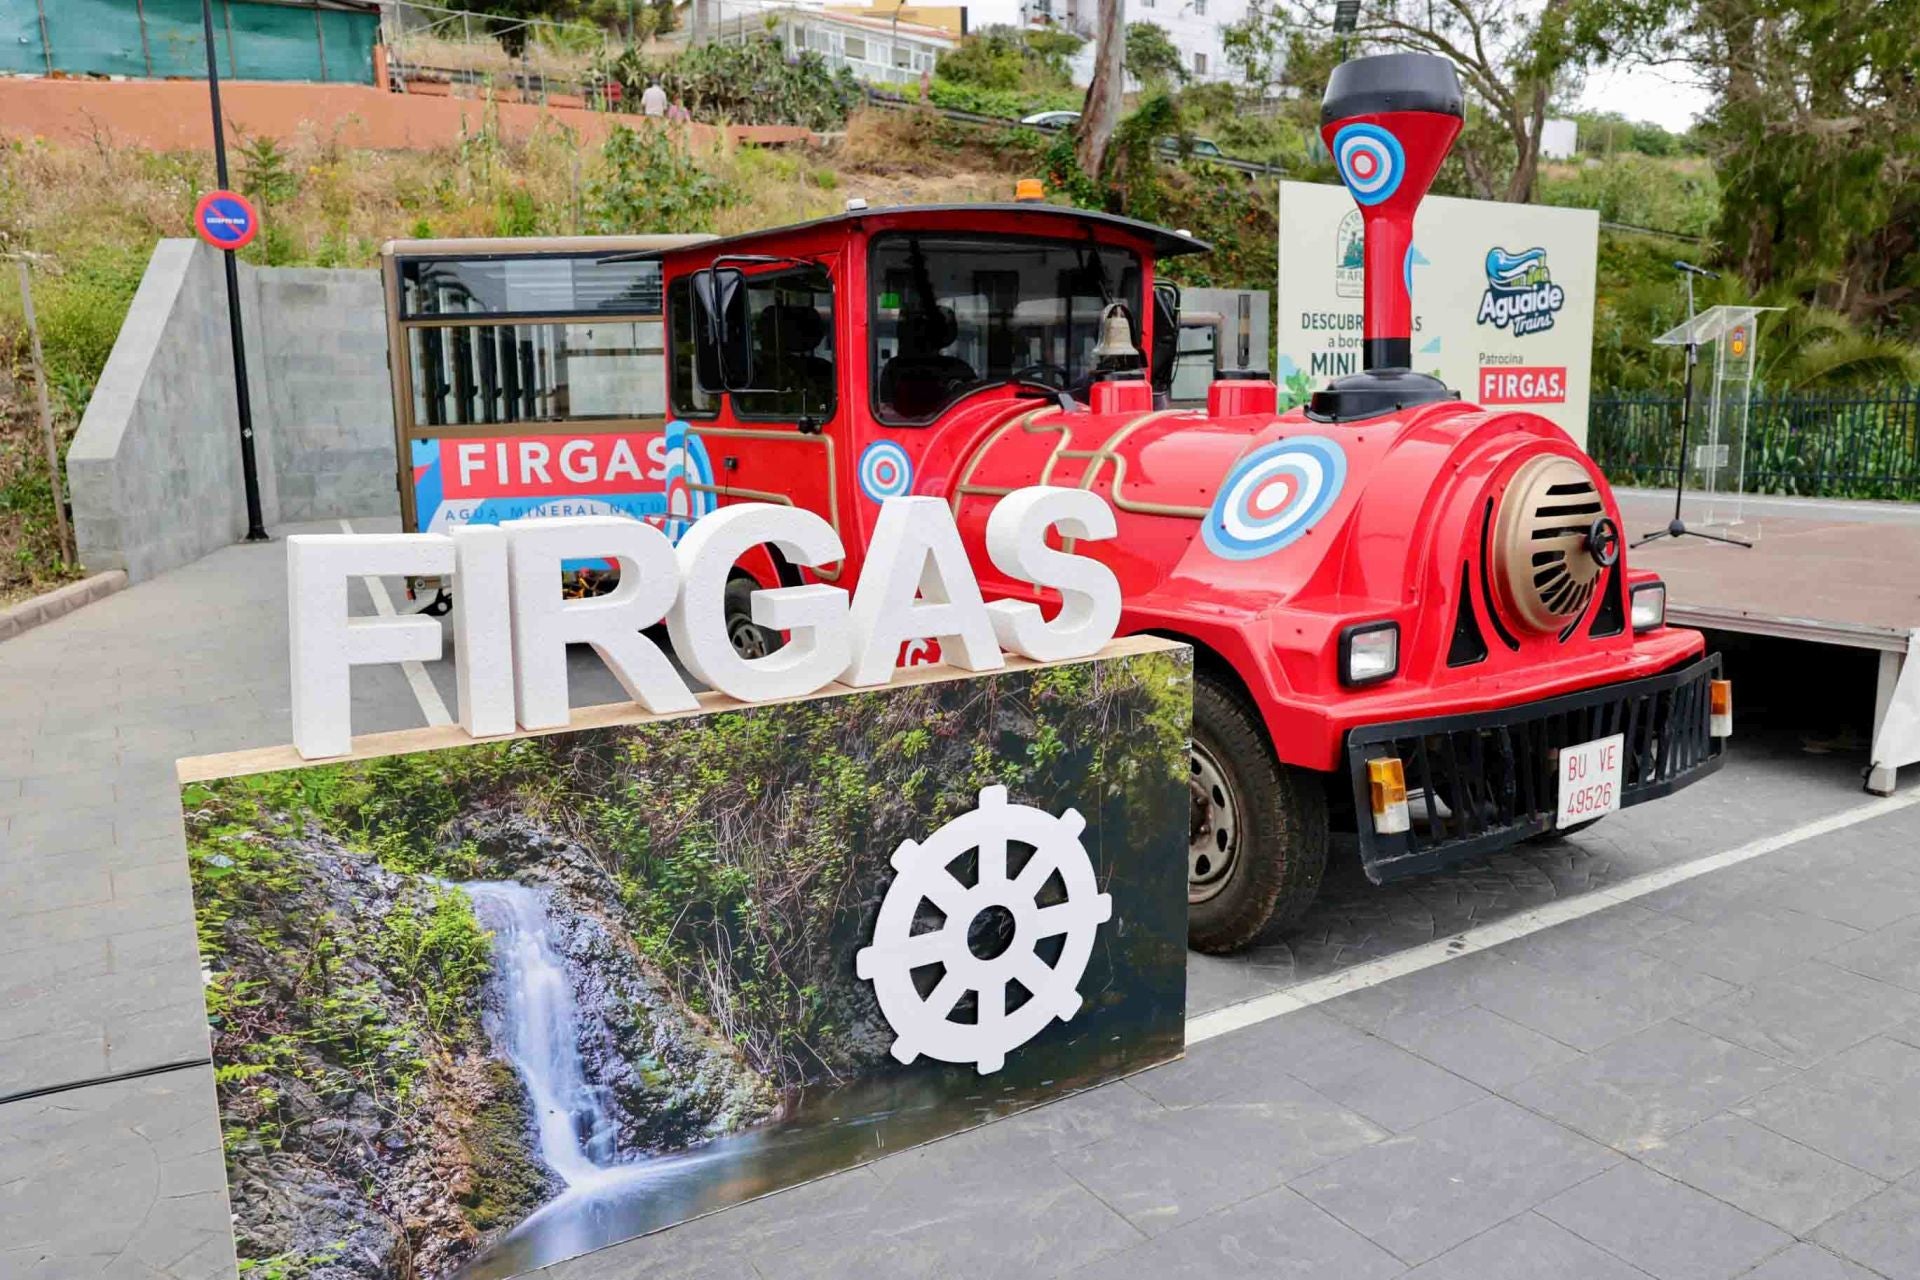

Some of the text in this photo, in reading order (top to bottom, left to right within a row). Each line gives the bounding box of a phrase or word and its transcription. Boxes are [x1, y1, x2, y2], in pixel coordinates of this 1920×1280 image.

[1478, 282, 1563, 326] Aguaide
[1301, 312, 1364, 330] DESCUBR
[1513, 312, 1553, 335] Trains
[1328, 333, 1363, 349] a bor
[1311, 352, 1356, 376] MINI
[1479, 352, 1524, 365] Patrocina
[444, 501, 667, 521] AGUA MINERAL NATU
[286, 484, 1123, 761] FIRGAS
[1568, 744, 1616, 781] BU VE
[1567, 782, 1612, 814] 49526
